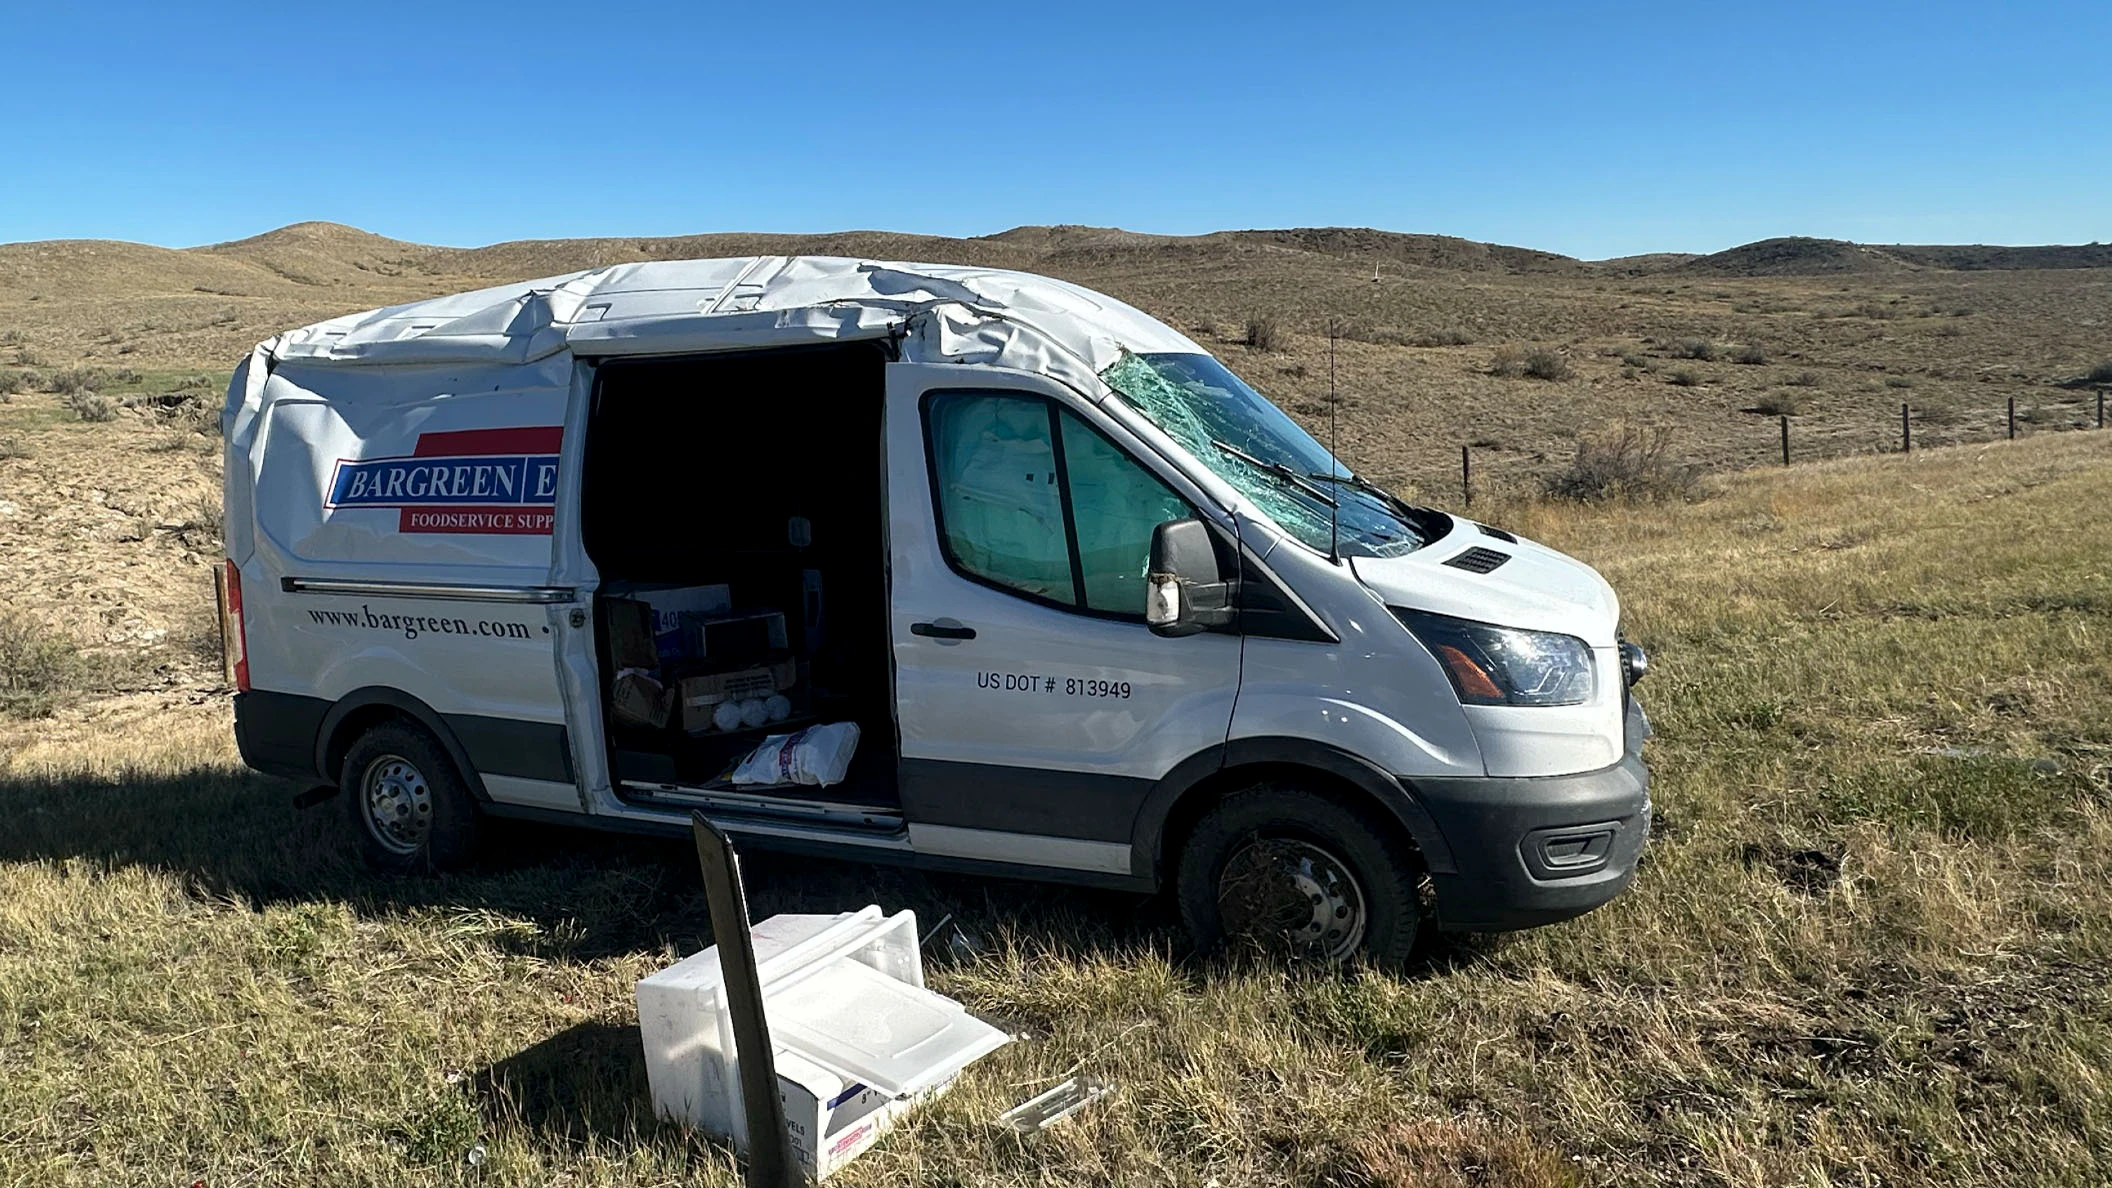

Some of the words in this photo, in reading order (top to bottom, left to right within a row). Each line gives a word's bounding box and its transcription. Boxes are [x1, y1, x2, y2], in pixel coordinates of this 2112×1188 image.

[347, 463, 518, 499] BARGREEN
[535, 464, 558, 498] E
[410, 512, 514, 529] FOODSERVICE
[516, 512, 554, 529] SUPP
[308, 604, 532, 640] www.bargreen.com
[977, 671, 1001, 690] US
[1005, 674, 1041, 692] DOT
[1044, 677, 1056, 693] #
[1065, 678, 1132, 699] 813949
